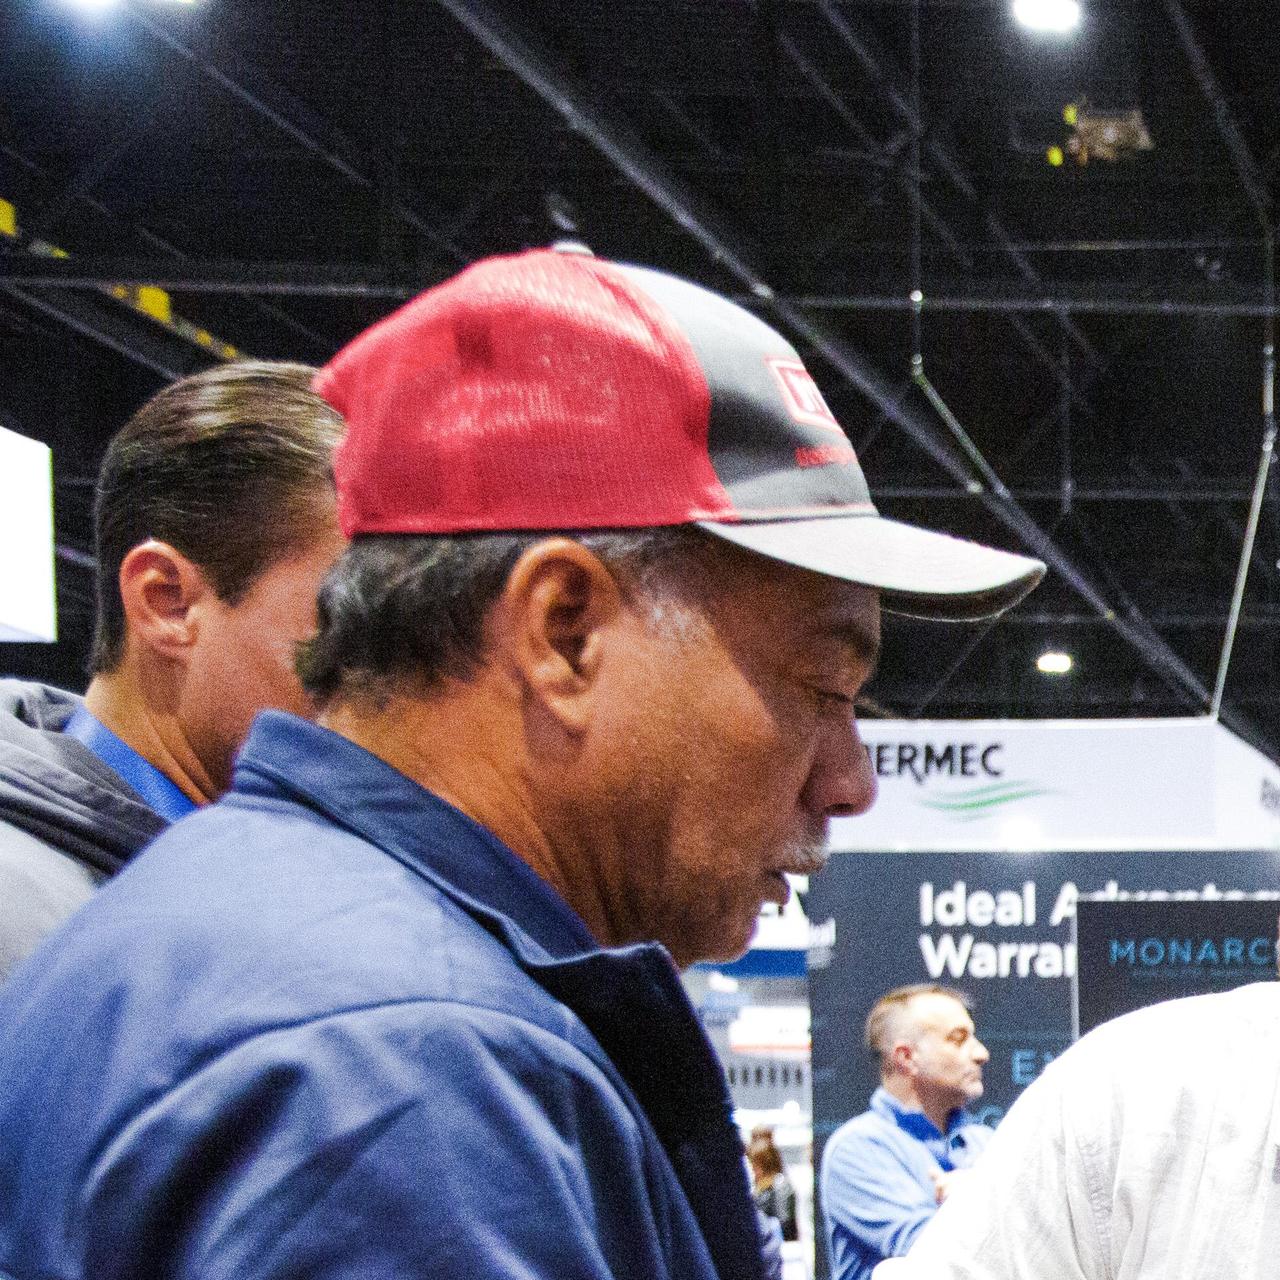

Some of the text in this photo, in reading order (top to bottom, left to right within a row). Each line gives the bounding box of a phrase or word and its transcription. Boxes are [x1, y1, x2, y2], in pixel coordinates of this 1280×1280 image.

[866, 742, 1004, 784] ERMEC
[919, 880, 1037, 927] Ideal
[1107, 936, 1273, 967] MONARC
